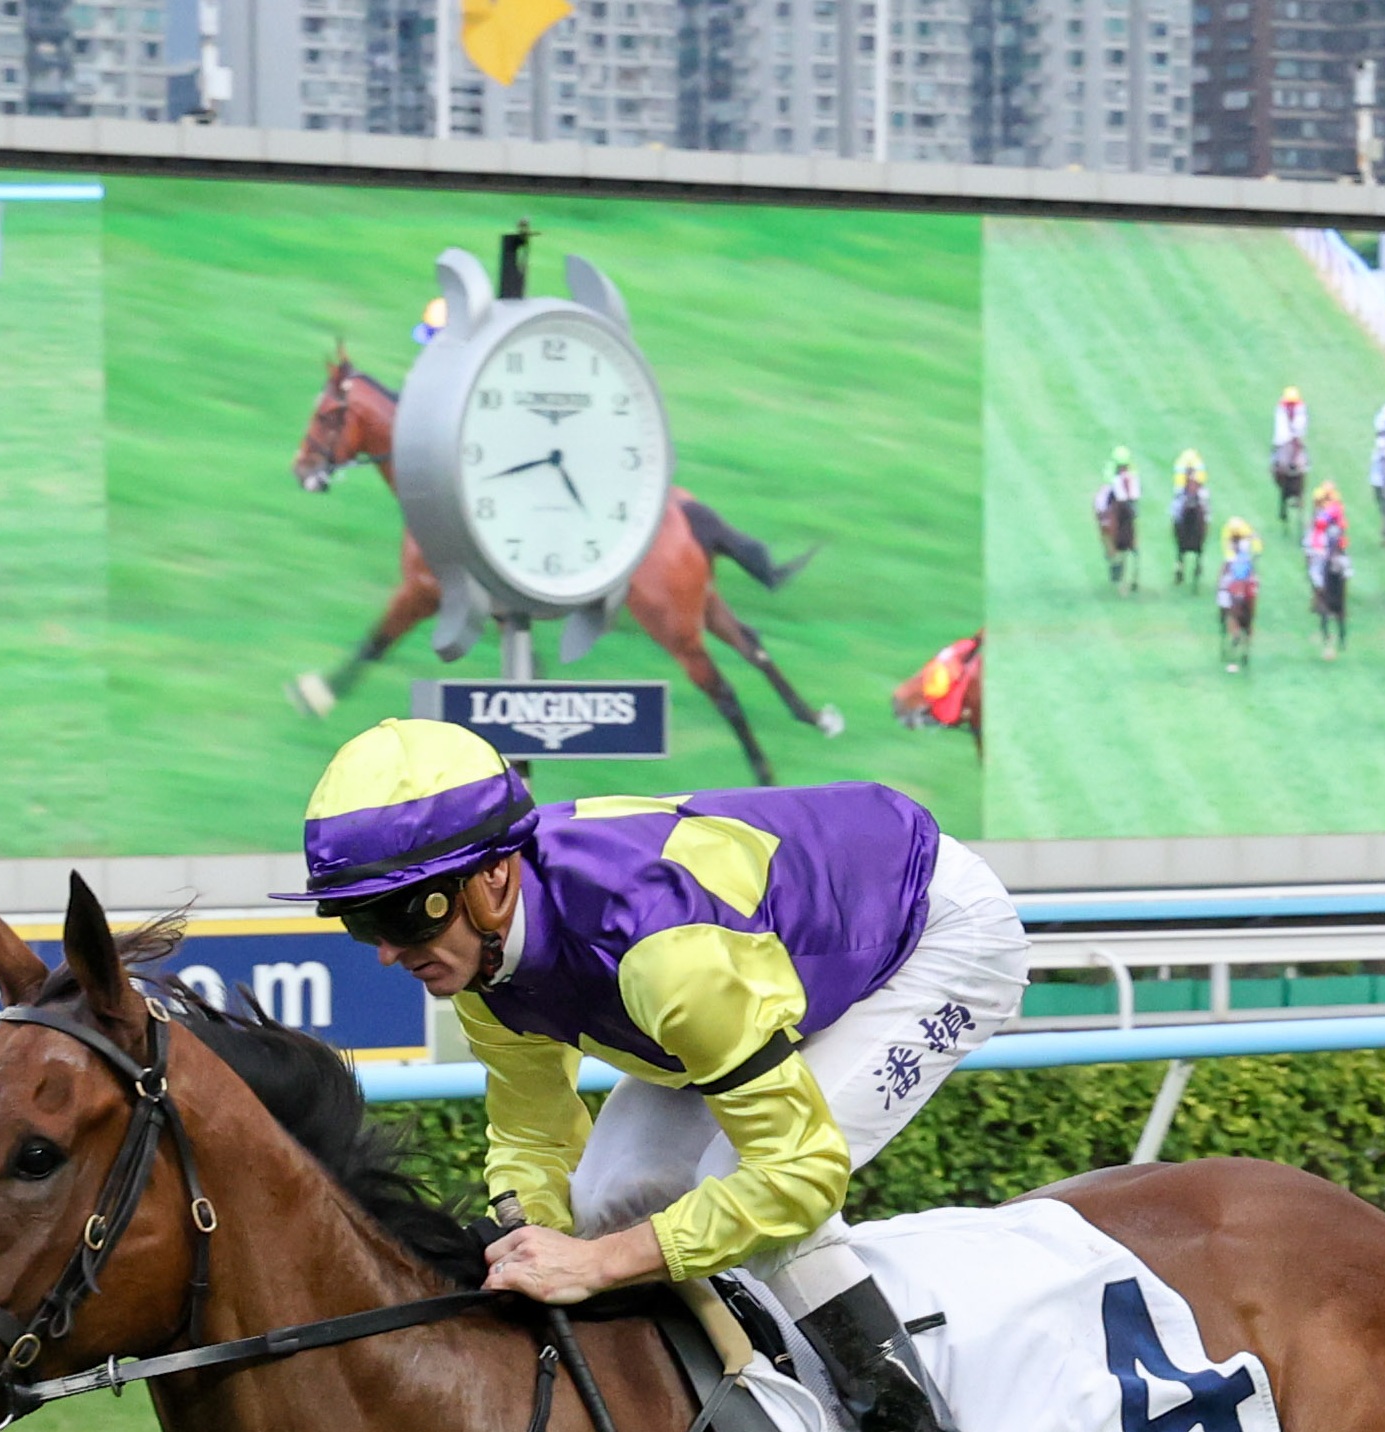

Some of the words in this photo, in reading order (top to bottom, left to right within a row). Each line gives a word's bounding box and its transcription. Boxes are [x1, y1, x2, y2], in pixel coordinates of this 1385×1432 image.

[623, 446, 642, 471] 3
[476, 497, 496, 520] 8
[608, 501, 627, 522] 4
[505, 538, 523, 561] 7
[584, 540, 601, 562] 5
[543, 553, 562, 576] 6
[469, 691, 637, 725] LONGINES
[873, 1002, 977, 1111] 潘頓
